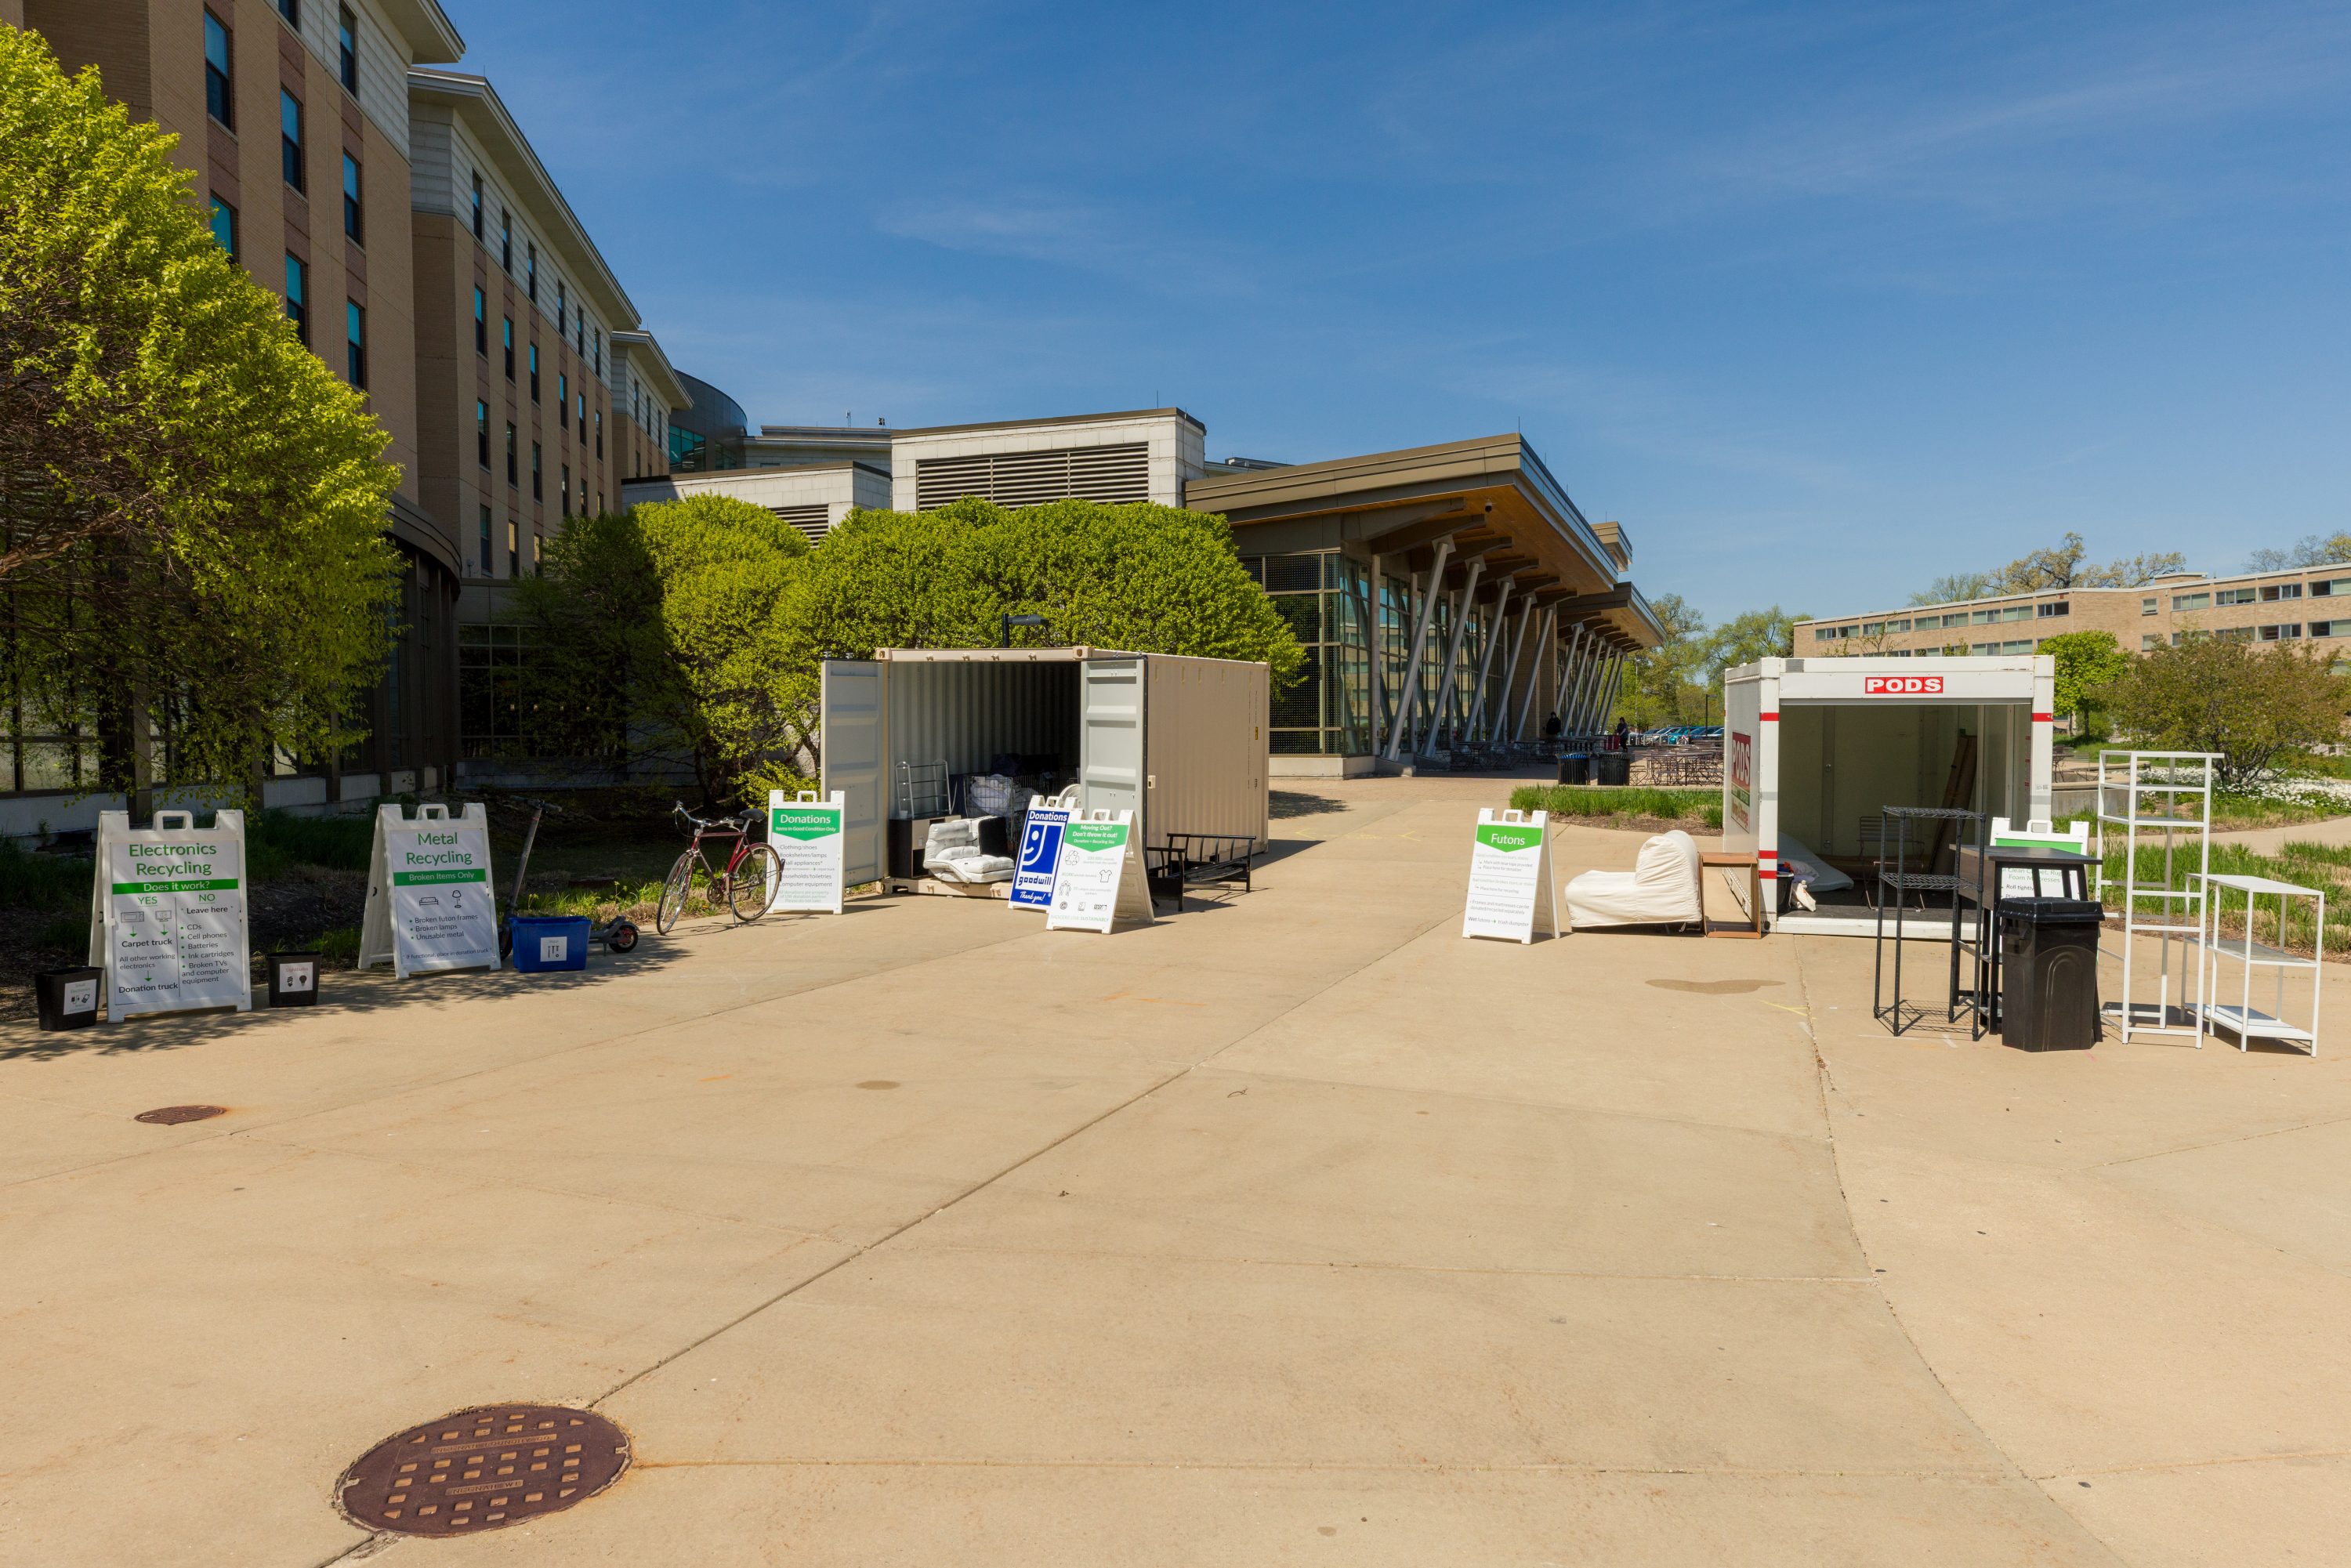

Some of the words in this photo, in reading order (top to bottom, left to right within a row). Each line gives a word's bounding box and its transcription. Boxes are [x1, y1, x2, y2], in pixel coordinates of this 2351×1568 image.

[1867, 679, 1941, 692] PODS
[1732, 740, 1750, 784] PODS
[781, 814, 831, 824] Donations
[1029, 811, 1067, 821] Donations
[417, 831, 458, 846] Metal
[1491, 834, 1526, 846] Futons
[129, 842, 217, 856] Electronics
[406, 850, 473, 866] Recycling
[136, 861, 212, 877] Recycling
[1018, 876, 1052, 885] goodwill
[143, 883, 169, 892] Does
[181, 881, 210, 890] work?
[138, 896, 158, 905] YES
[199, 893, 216, 902] NO
[201, 951, 234, 959] cartridges
[197, 968, 229, 977] computer
[182, 976, 219, 985] equipment
[118, 984, 156, 994] Donation
[158, 982, 178, 990] truck
